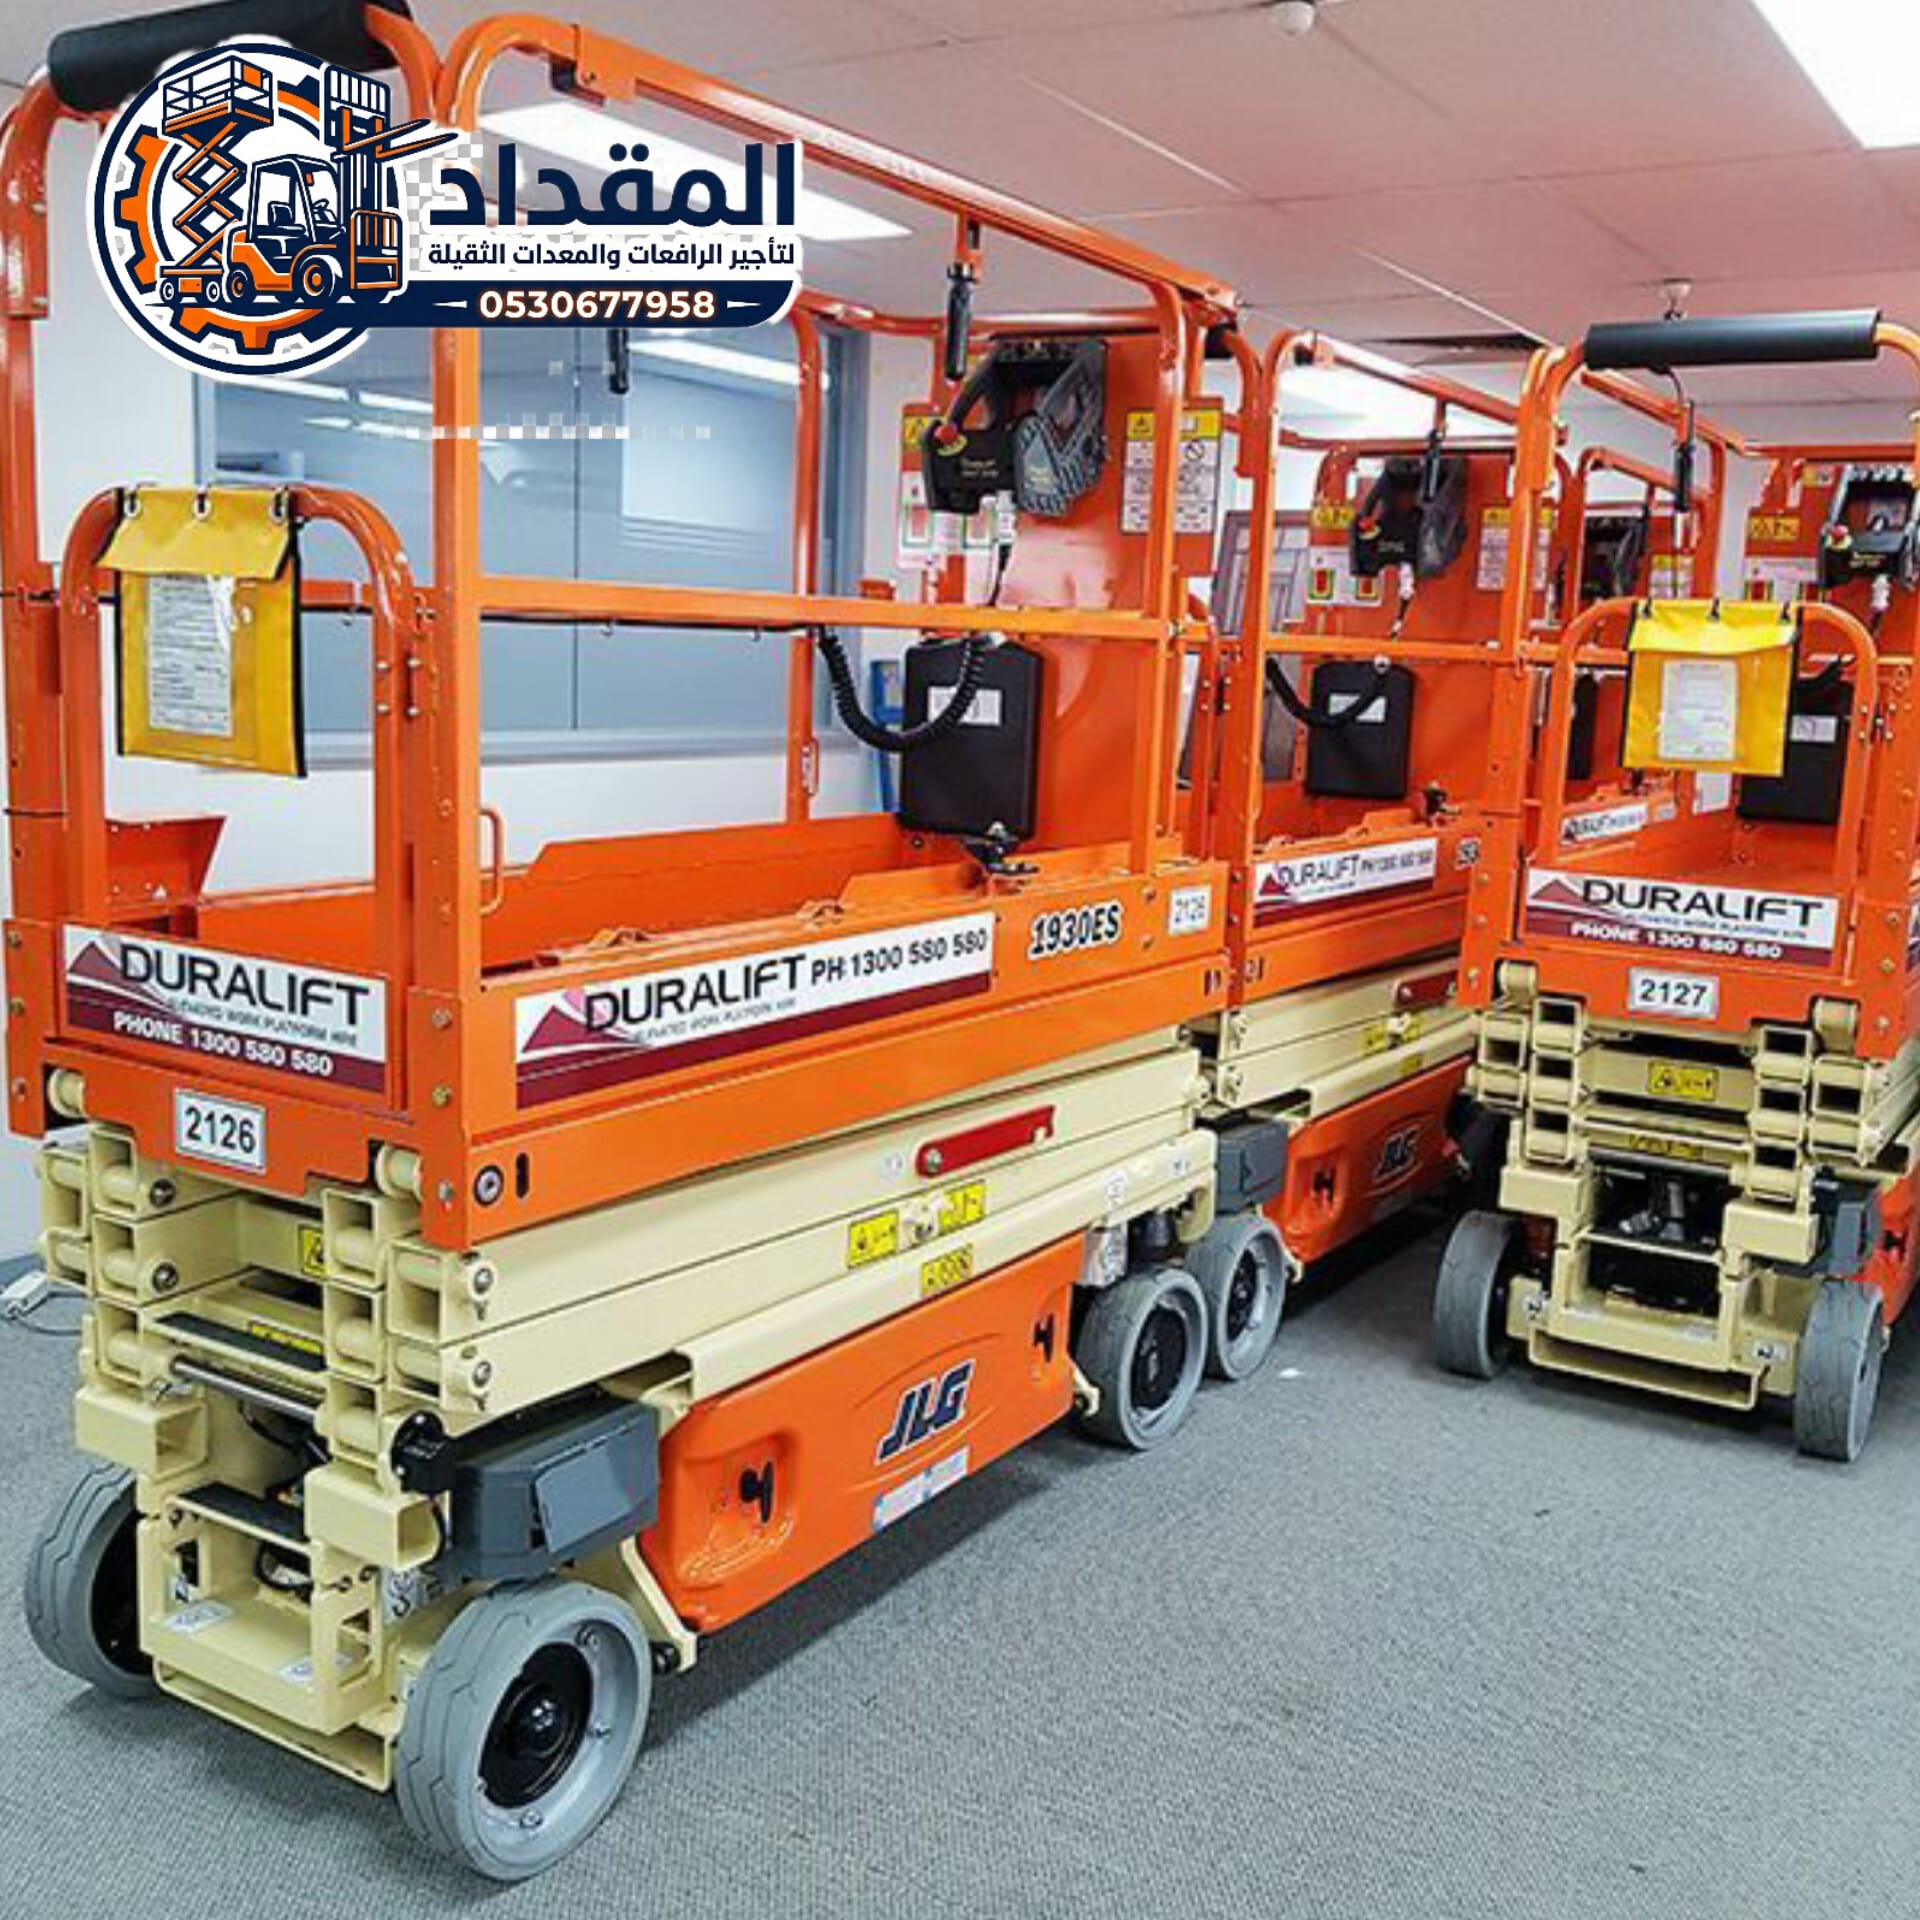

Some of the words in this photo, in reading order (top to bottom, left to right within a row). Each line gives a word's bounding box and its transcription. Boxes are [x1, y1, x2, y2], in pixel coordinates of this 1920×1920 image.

[1030, 903, 1119, 954] 1930ES
[1582, 879, 1823, 927] DURALIFT
[1571, 921, 1639, 942] PHONE
[119, 944, 370, 1027] DURALIFT
[585, 954, 806, 1032] DURALIFT
[851, 946, 903, 977] 1300
[908, 936, 948, 966] 580
[953, 928, 988, 957] 580
[1640, 978, 1708, 1006] 2127
[113, 1011, 183, 1044] PHONE
[189, 1028, 240, 1057] 1300
[245, 1041, 286, 1067] 580
[291, 1050, 334, 1076] 580
[184, 1106, 256, 1155] 2126
[878, 1360, 973, 1462] JLG
